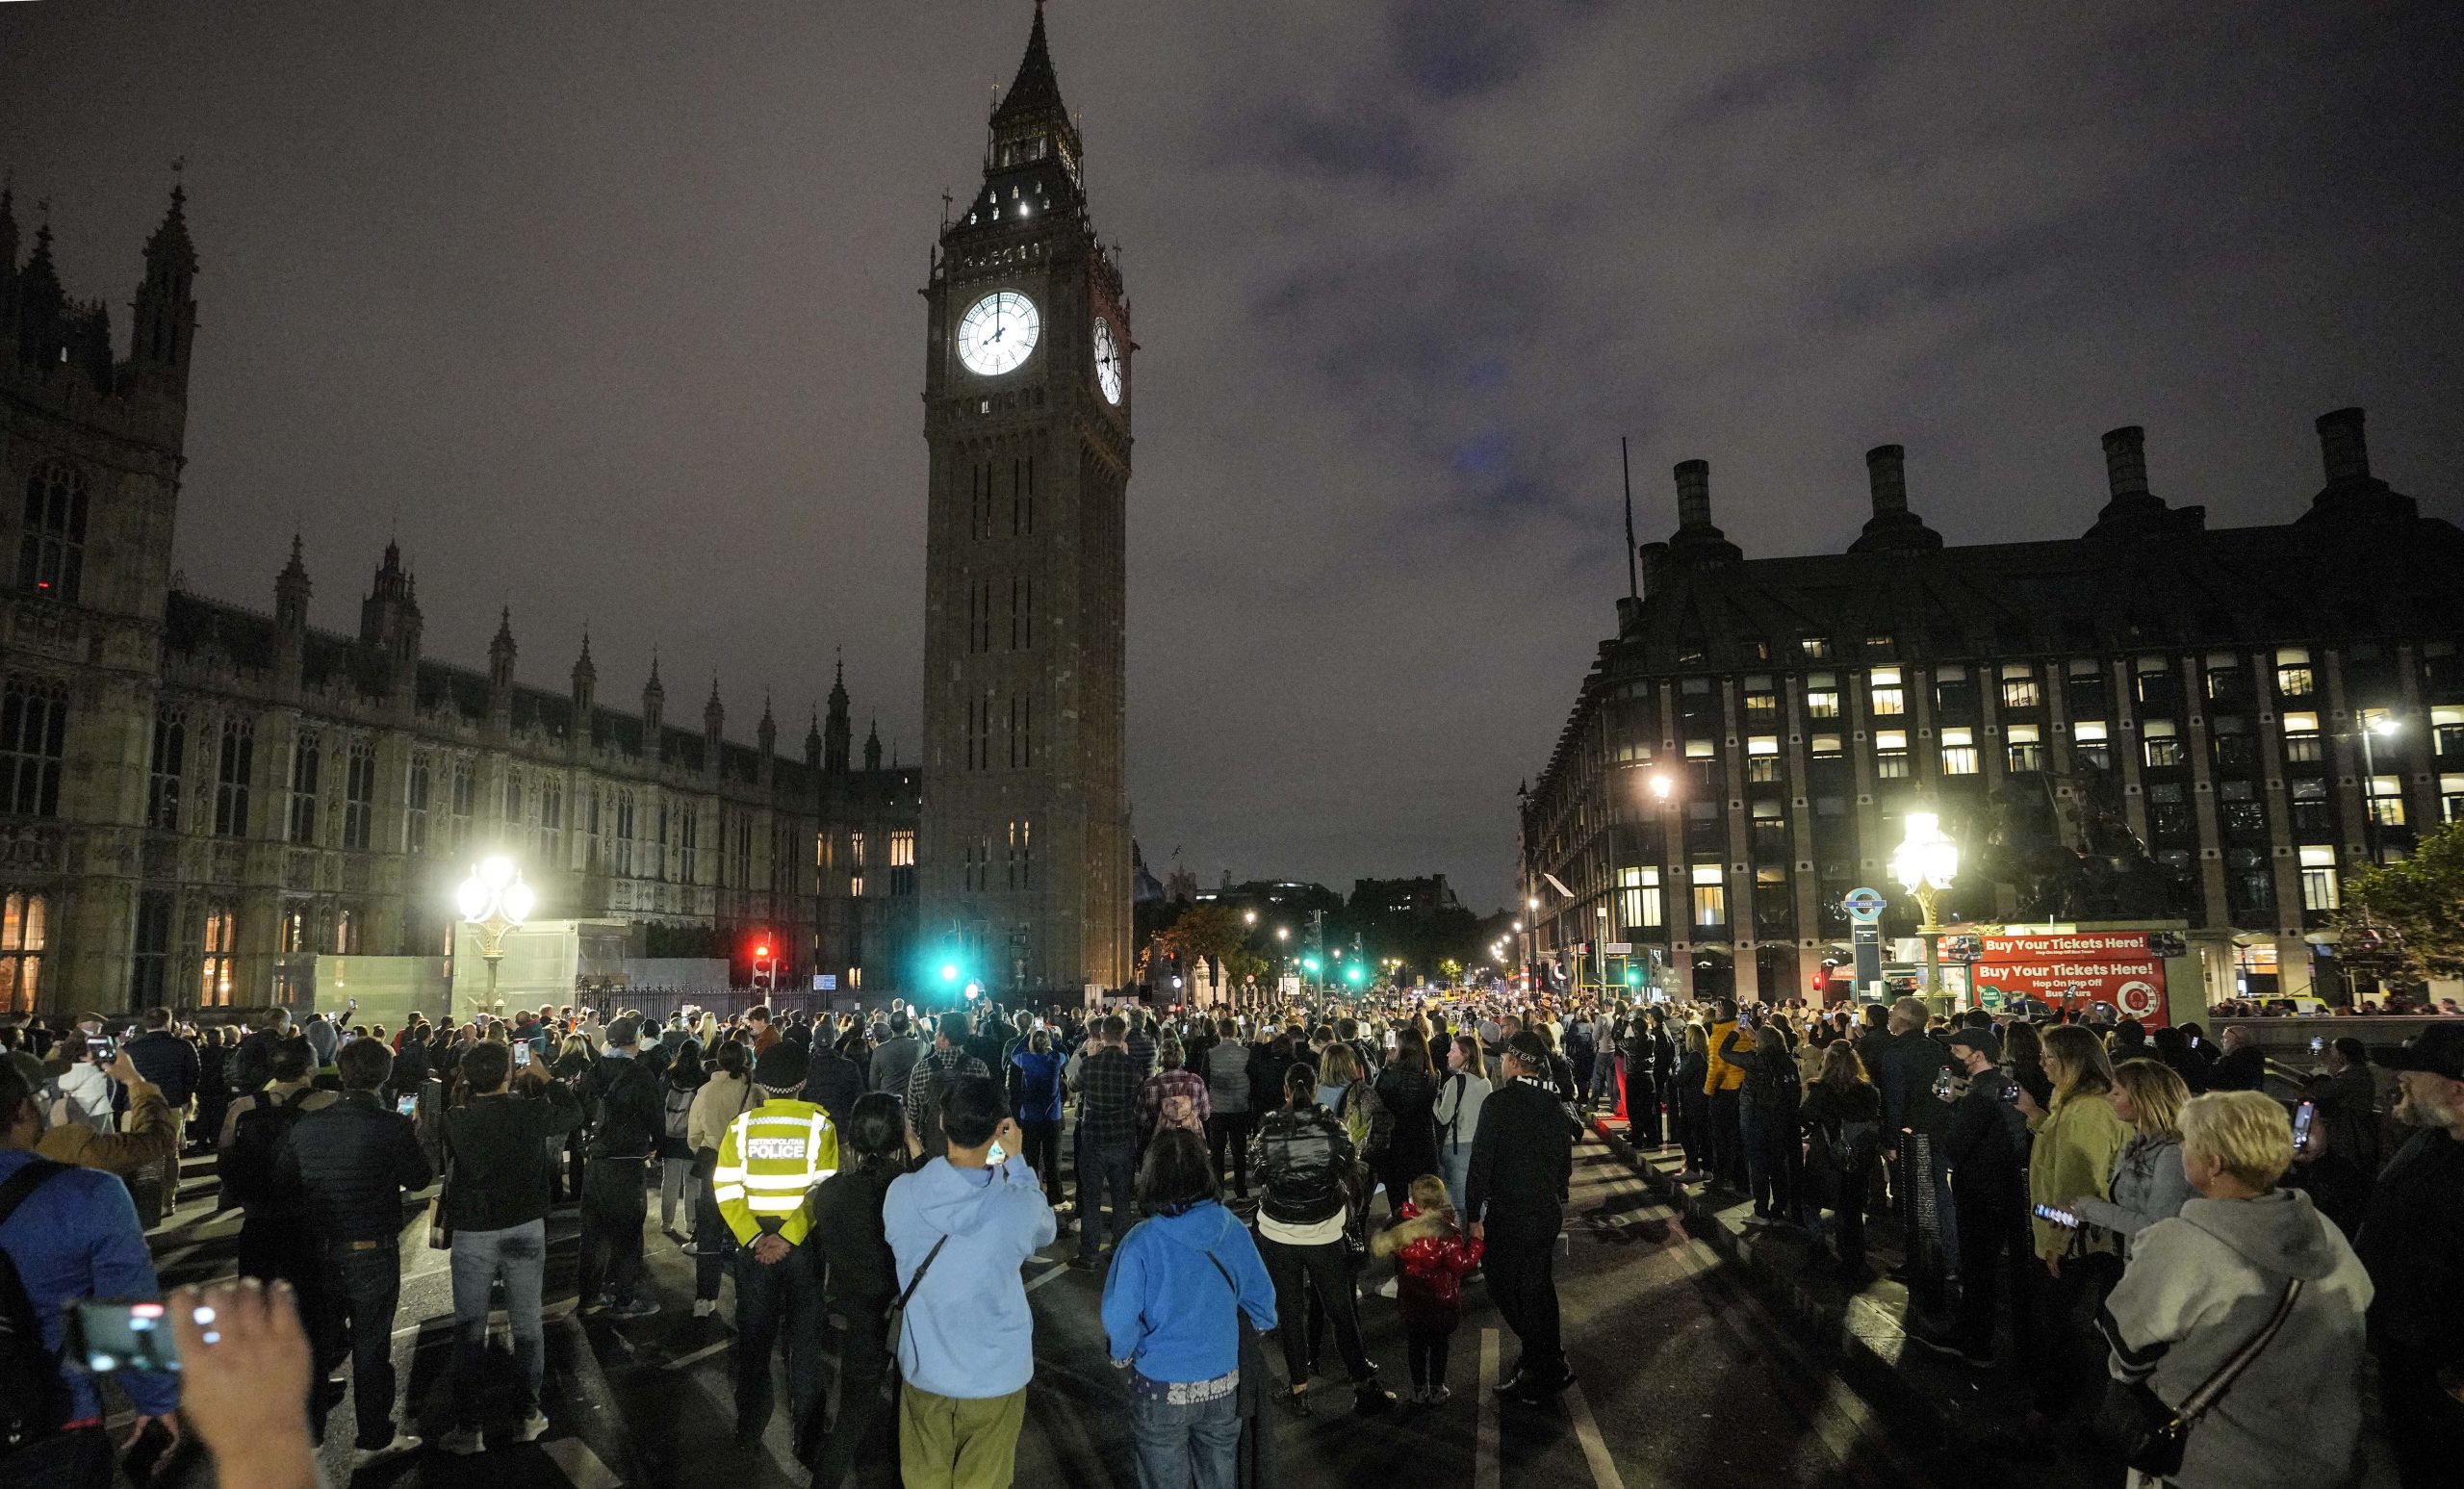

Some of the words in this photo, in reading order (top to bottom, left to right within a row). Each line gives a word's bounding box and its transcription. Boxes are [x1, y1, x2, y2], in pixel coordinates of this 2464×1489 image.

[1986, 939, 2014, 954] Buy
[2015, 939, 2049, 950] Your
[2050, 937, 2103, 950] Tickets
[2105, 937, 2144, 948] Here!
[1979, 965, 2011, 981] Buy
[2011, 964, 2049, 977] Your
[2050, 963, 2109, 976] Tickets
[2110, 963, 2154, 975] Here!
[2032, 980, 2052, 989] Hop
[2052, 979, 2067, 988] On
[2067, 979, 2088, 988] Hop
[2088, 978, 2103, 987] Off
[1507, 1042, 1521, 1056] EA7
[1521, 1053, 1537, 1064] EA7
[748, 1144, 805, 1159] POLICE
